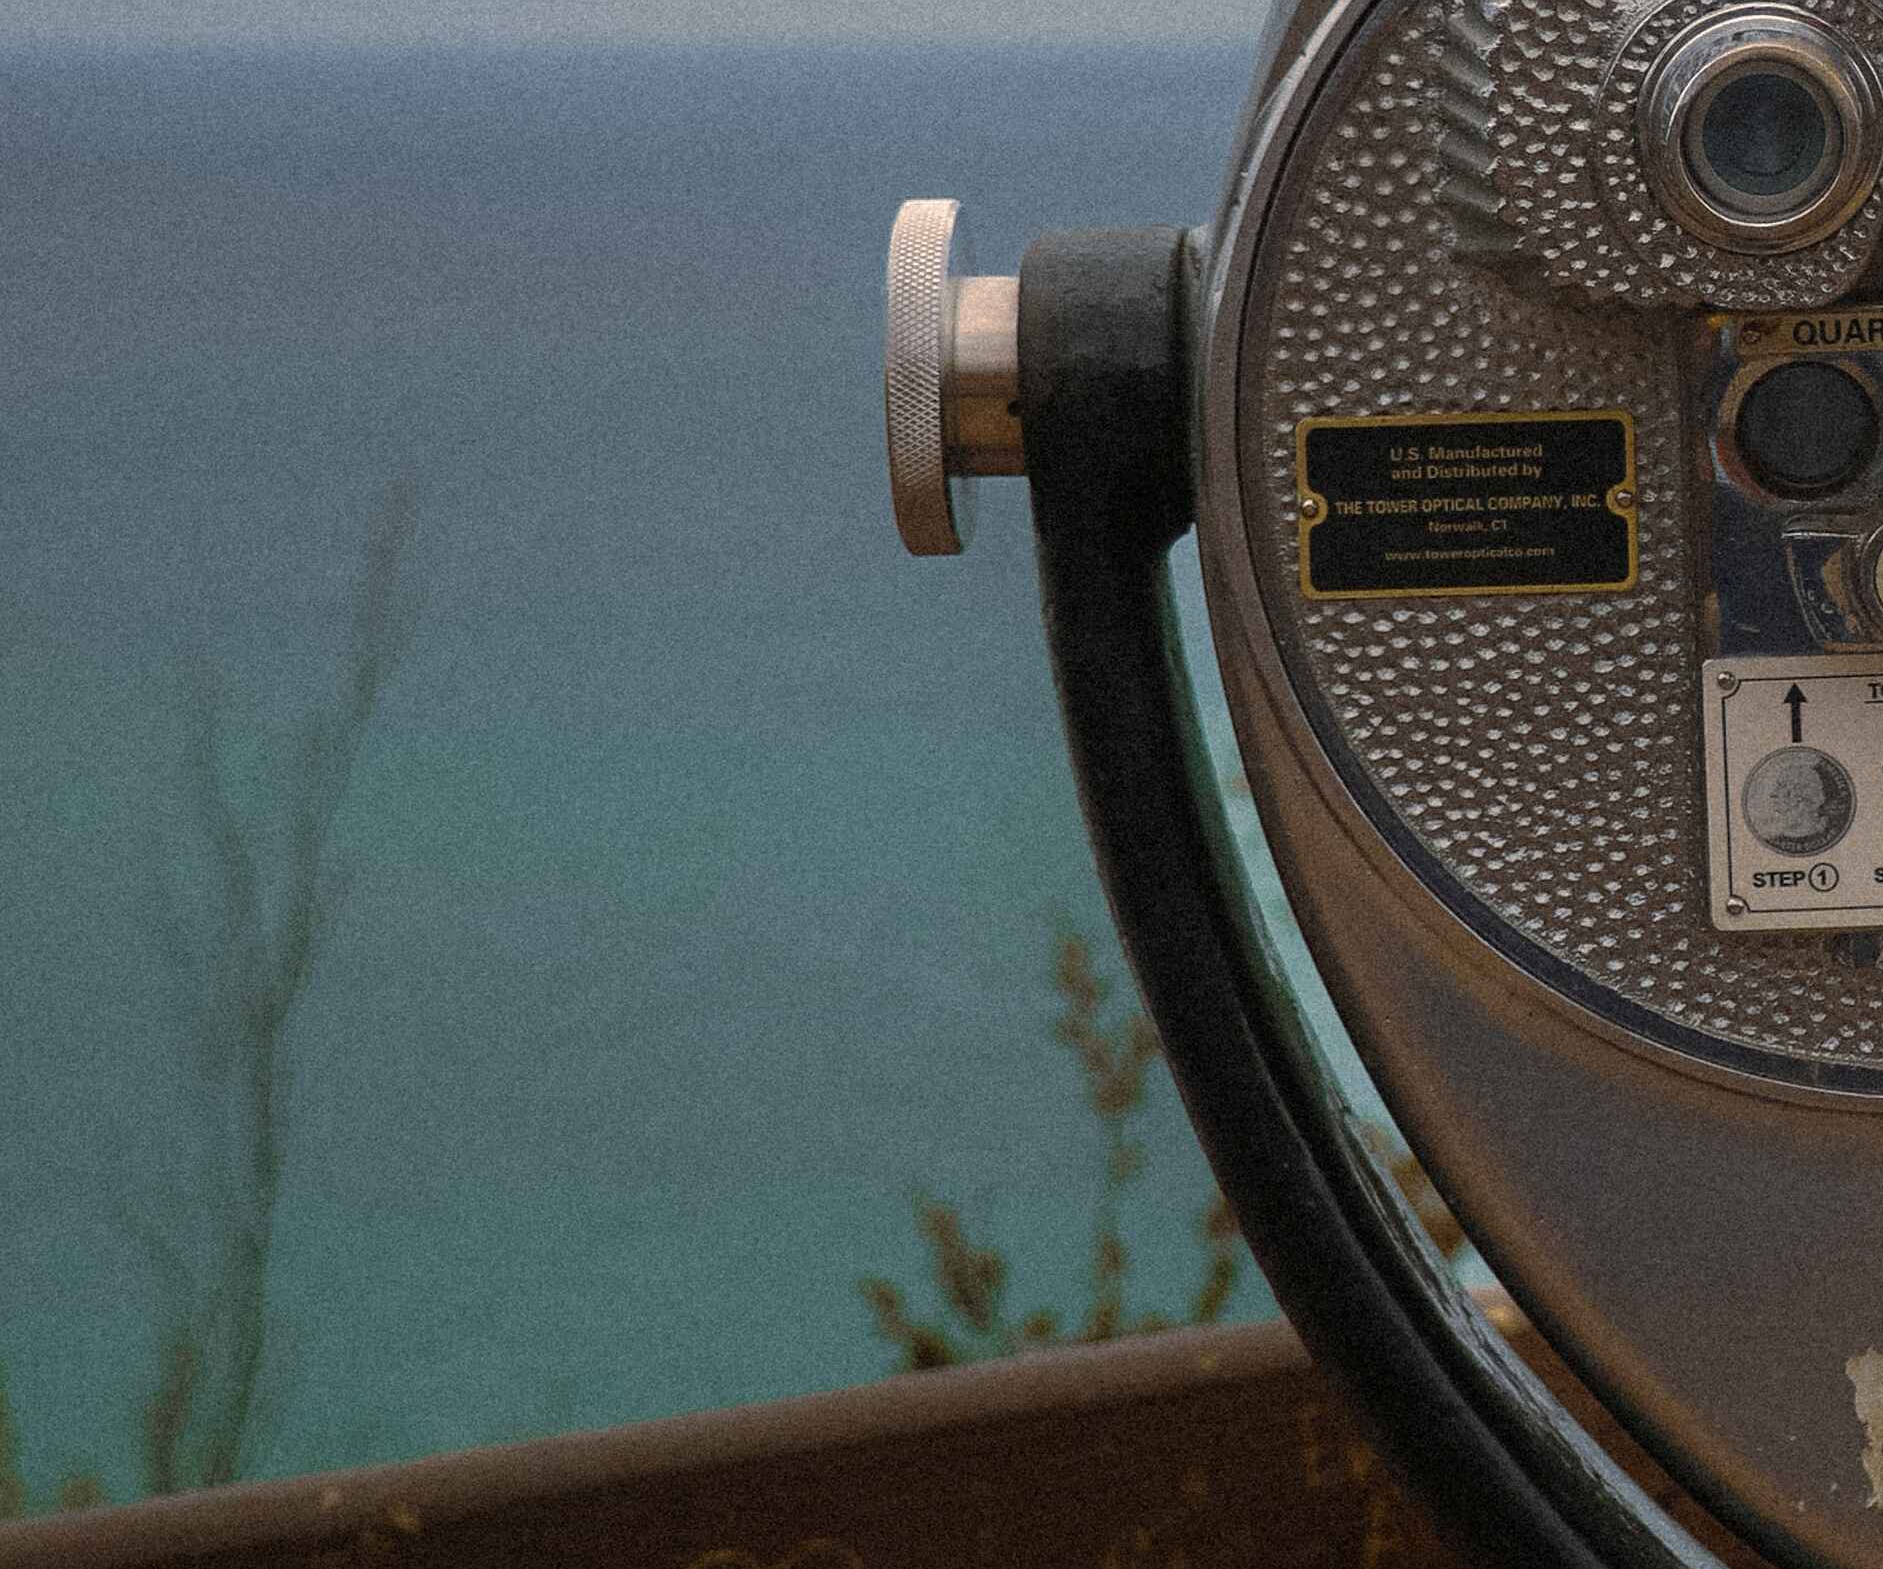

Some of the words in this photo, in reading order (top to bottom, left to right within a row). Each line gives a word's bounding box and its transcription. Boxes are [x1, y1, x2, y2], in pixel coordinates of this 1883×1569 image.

[1429, 444, 1544, 461] Manufactured
[1391, 465, 1423, 480] and
[1427, 463, 1519, 479] Distributed
[1522, 462, 1543, 480] by
[1335, 501, 1362, 516] THE
[1368, 499, 1418, 515] TOWER
[1421, 497, 1485, 513] OPTICAL
[1488, 495, 1567, 512] COMPANY,
[1571, 494, 1601, 510] INC.
[1491, 519, 1507, 531] CT
[1753, 870, 1806, 888] STEP
